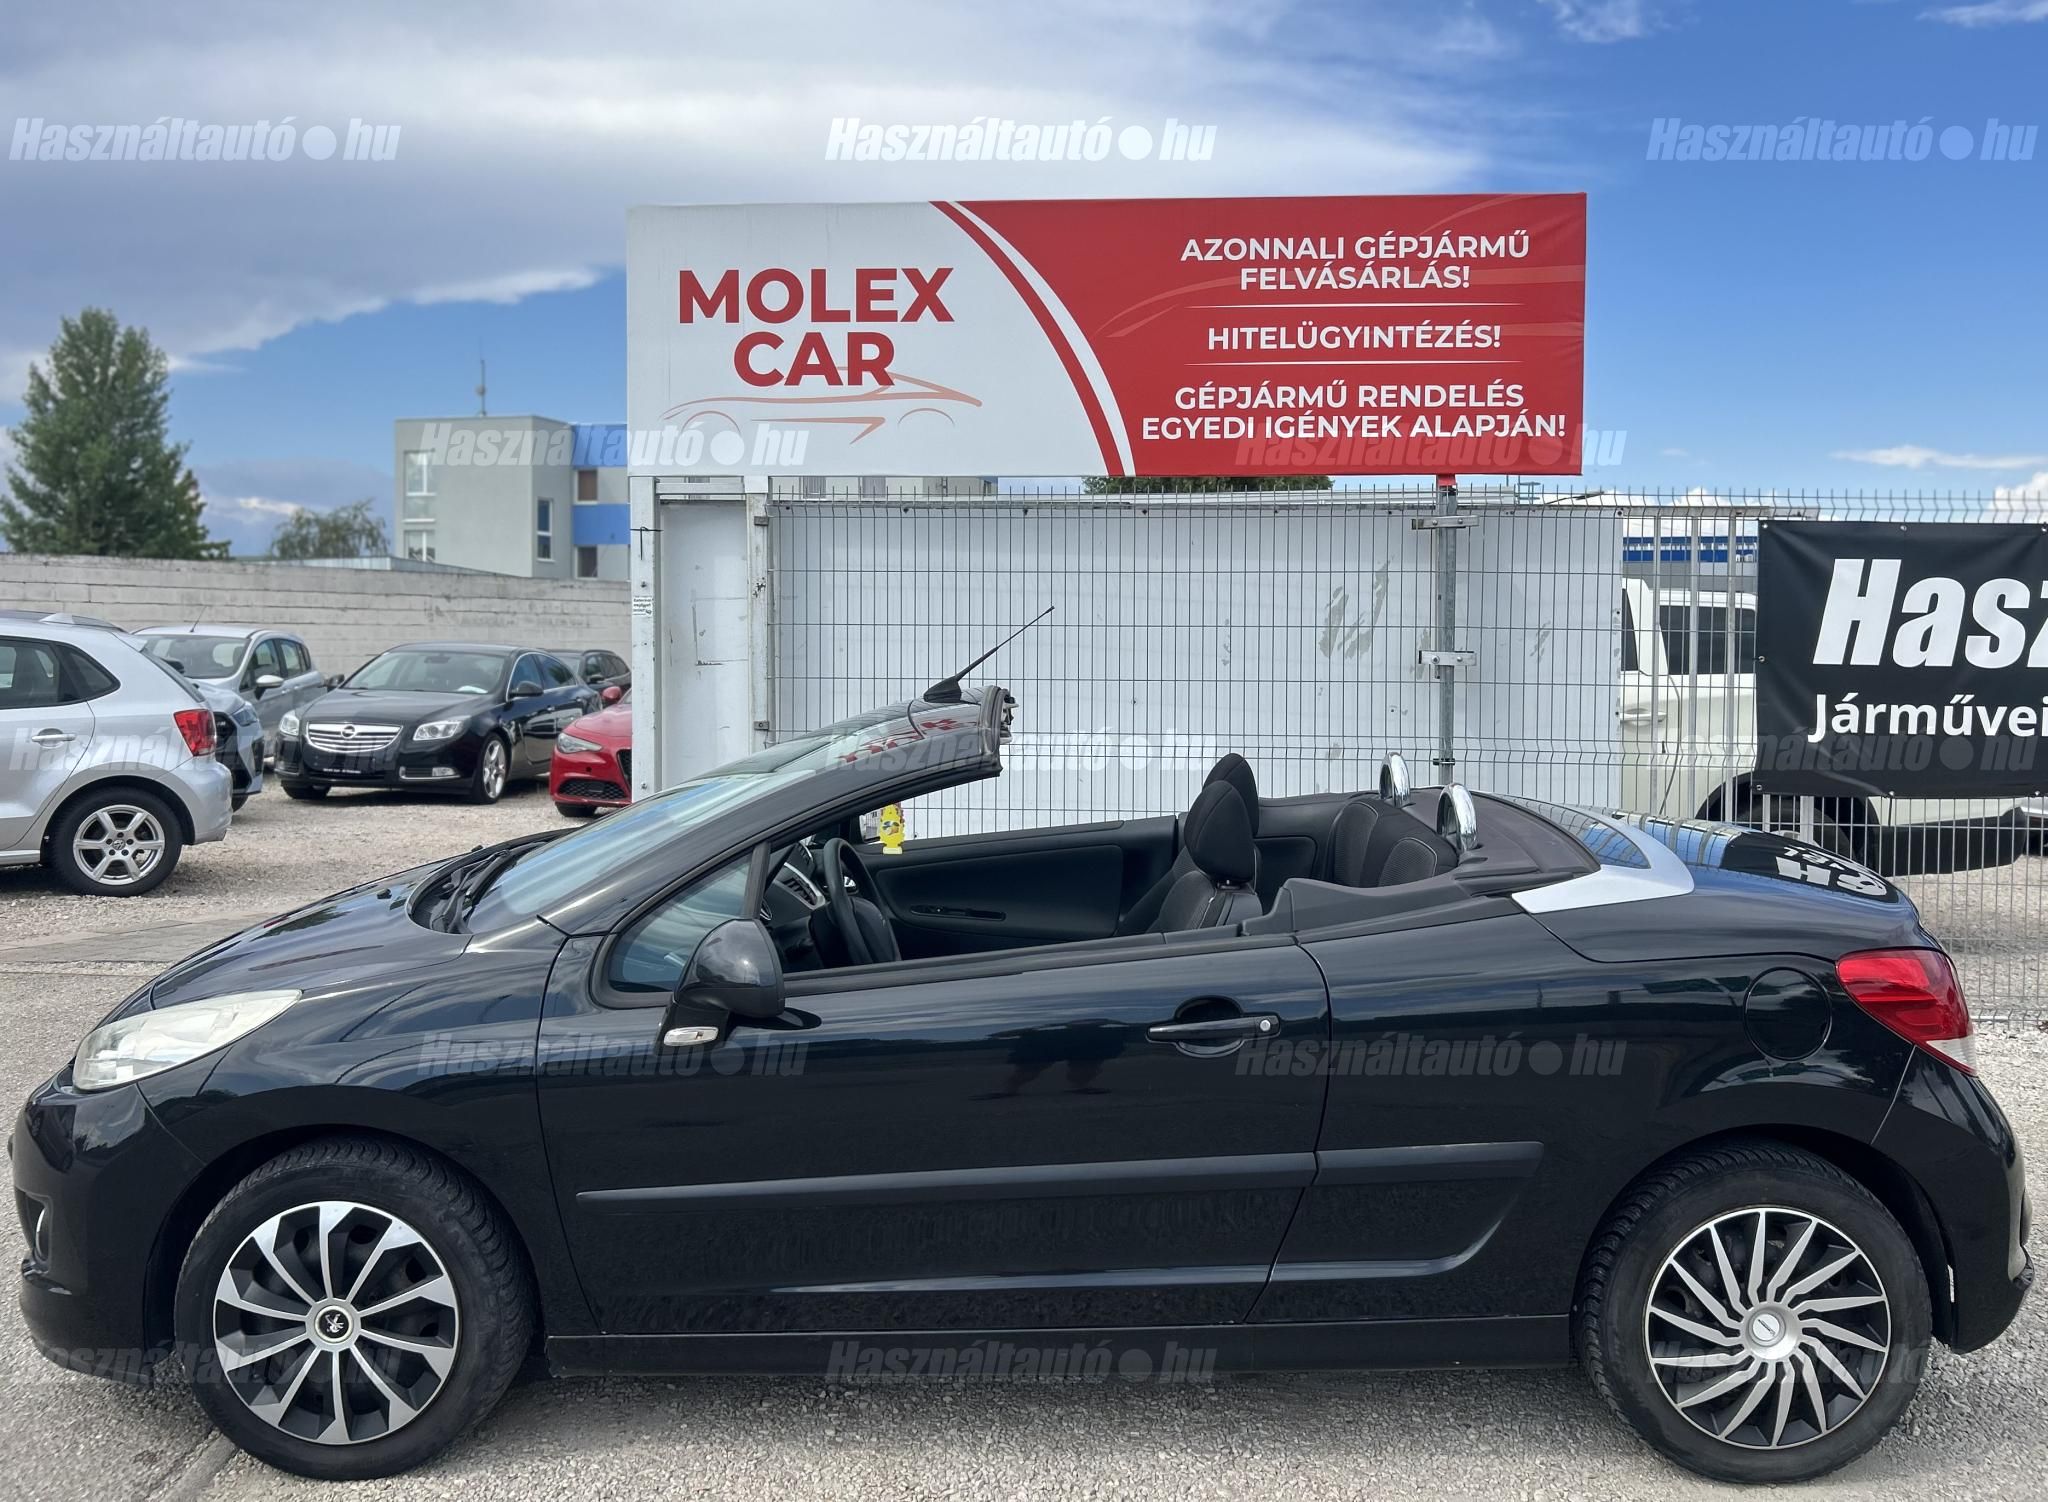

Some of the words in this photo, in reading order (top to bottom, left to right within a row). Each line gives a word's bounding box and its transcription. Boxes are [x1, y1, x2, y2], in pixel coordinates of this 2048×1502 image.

[1181, 237, 1343, 261] AZONNALI
[1355, 230, 1529, 259] GÉPJÁRMŰ
[1241, 260, 1470, 290] FELVÁSÁRLÁS!
[680, 269, 952, 323] MOLEX
[1208, 319, 1501, 350] HITELÜGYINTÉZÉS!
[734, 332, 894, 387] CAR
[1175, 379, 1347, 410] GÉPJÁRMŰ
[1359, 378, 1524, 408] RENDELÉS
[1142, 416, 1254, 440] EGYEDI
[1265, 409, 1402, 440] IGÉNYEK
[1410, 408, 1566, 438] ALAPJÁN!
